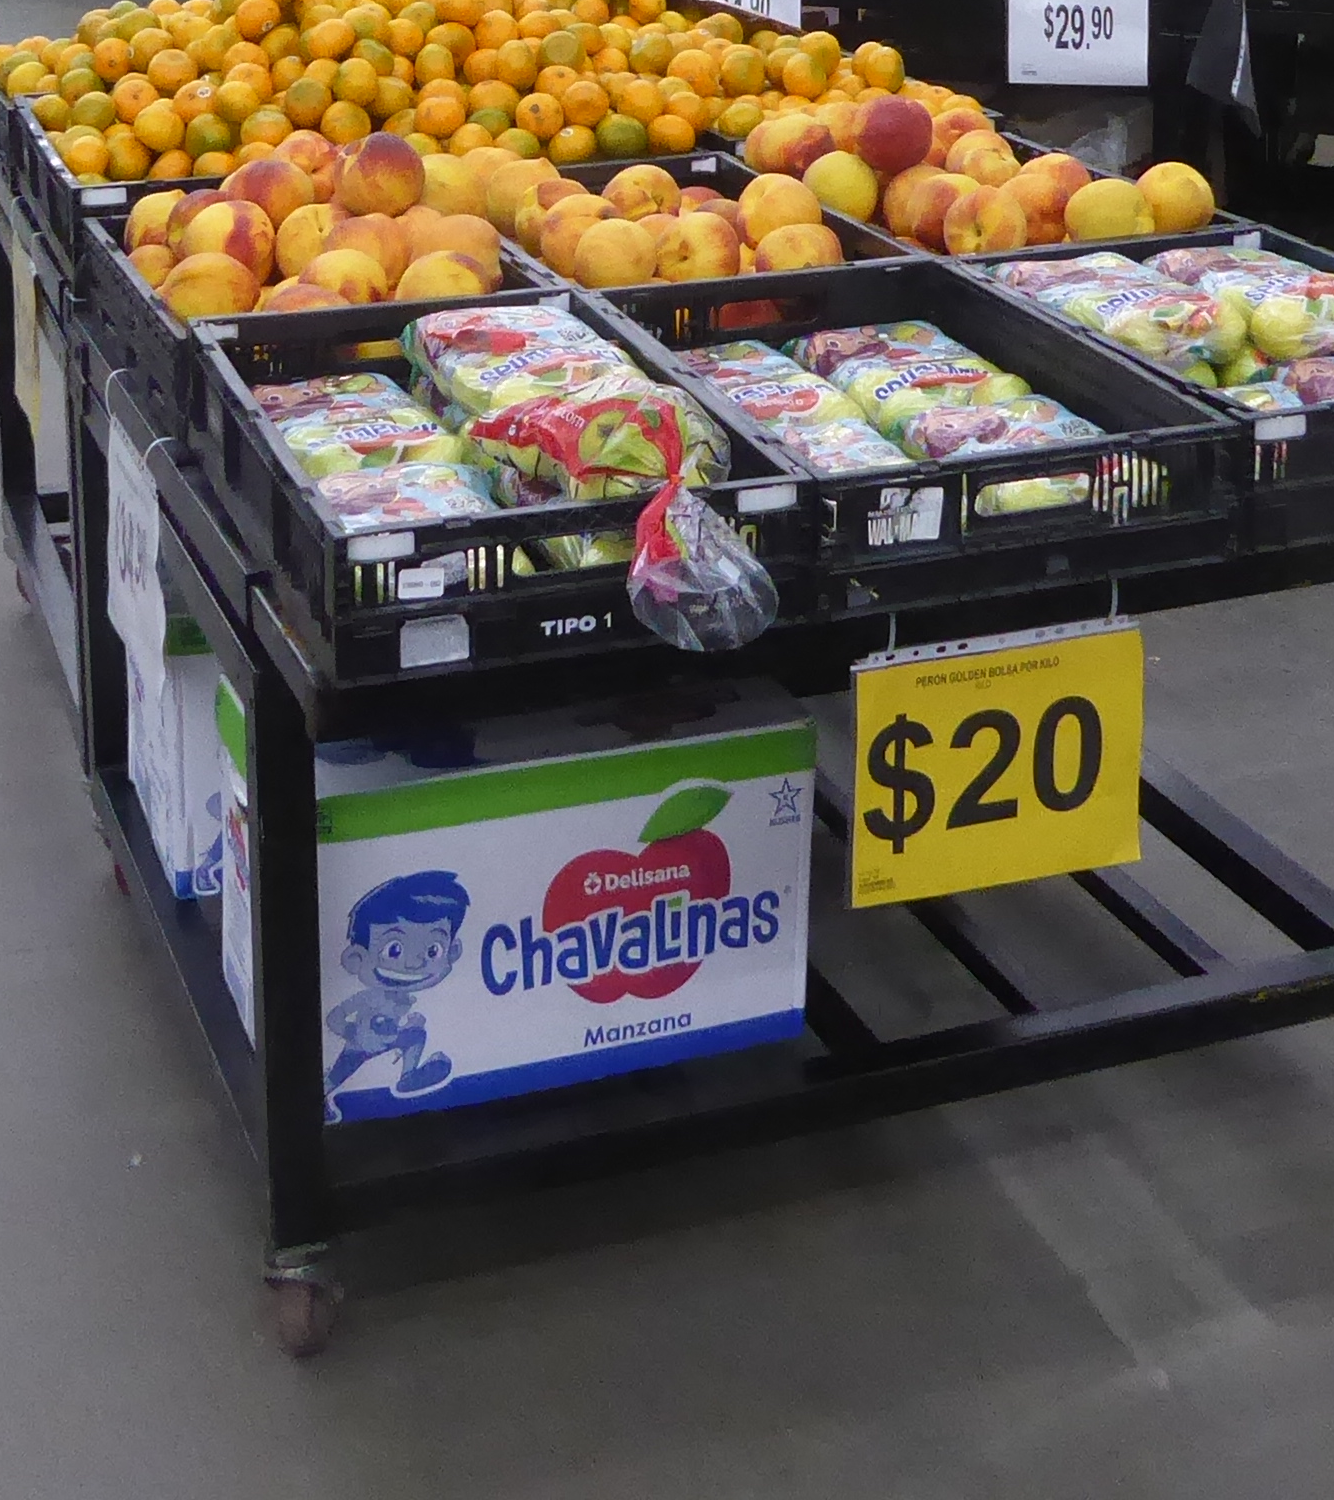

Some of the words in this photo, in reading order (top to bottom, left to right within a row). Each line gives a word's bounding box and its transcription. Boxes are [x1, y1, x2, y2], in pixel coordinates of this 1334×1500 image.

[1044, 2, 1114, 50] $29.90
[540, 615, 597, 636] TIPO
[603, 612, 612, 628] 1
[948, 667, 987, 684] GOLDEN
[1019, 659, 1039, 673] POR
[1040, 655, 1060, 669] KILO
[863, 696, 1103, 854] $20
[603, 863, 691, 892] Delisana
[583, 1012, 692, 1047] Manzana
